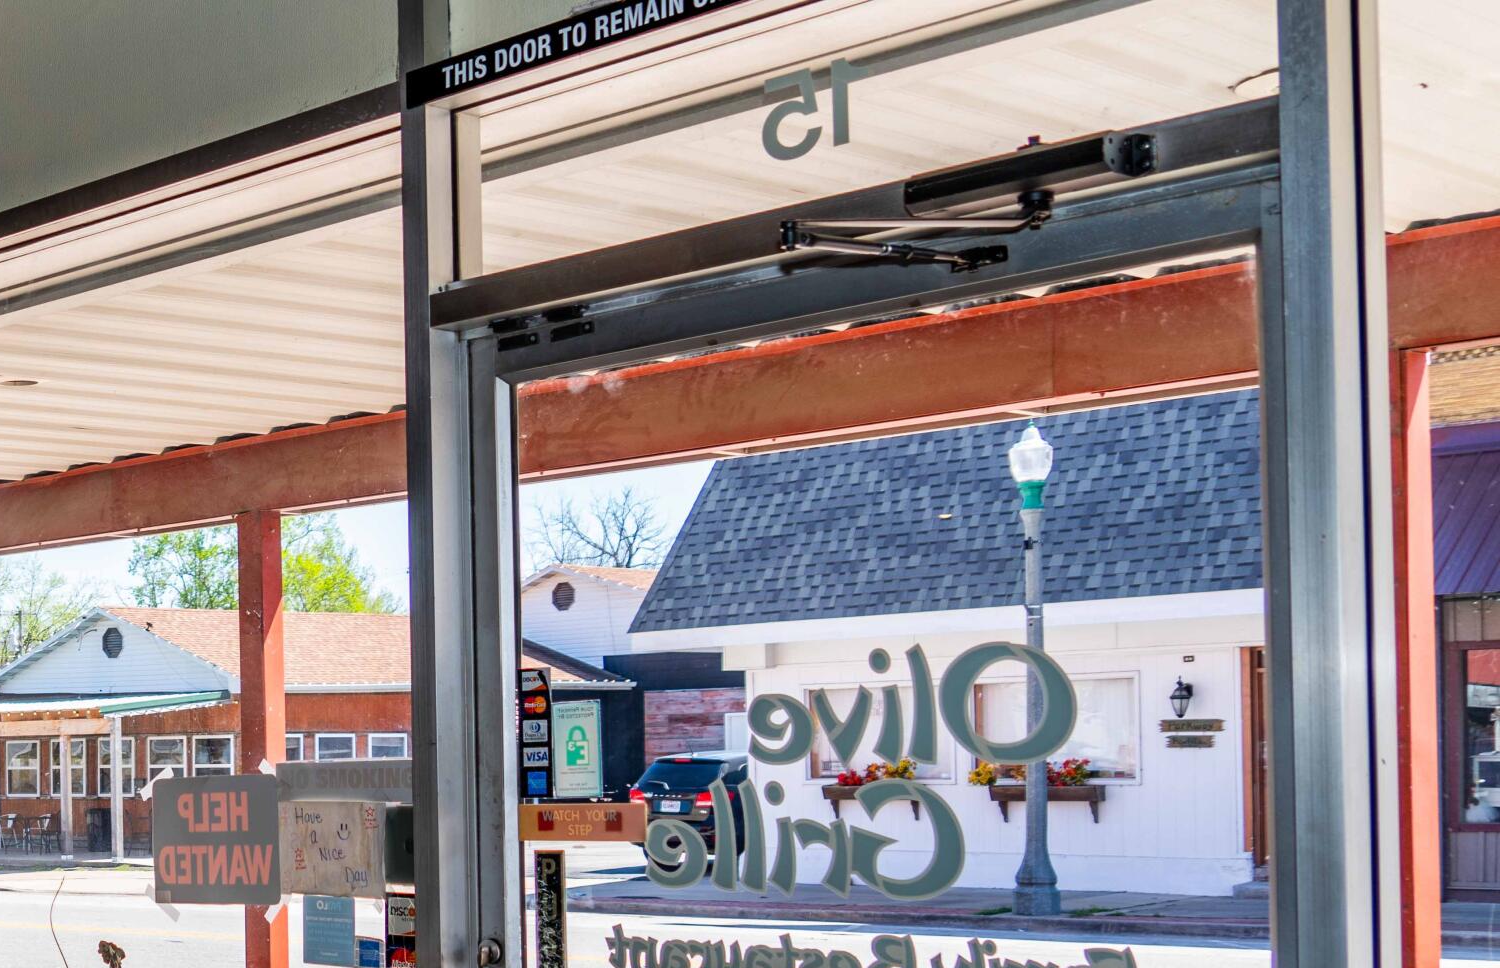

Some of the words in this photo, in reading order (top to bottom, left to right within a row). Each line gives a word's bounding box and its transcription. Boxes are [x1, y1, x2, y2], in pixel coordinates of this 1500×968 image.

[442, 55, 488, 88] THIS
[494, 33, 552, 73] DOOR
[558, 22, 587, 50] TO
[594, 0, 684, 41] REMAIN
[526, 751, 549, 762] VISA
[315, 767, 413, 789] SMOKING
[294, 807, 323, 825] Have
[542, 809, 580, 822] WATCH
[585, 809, 618, 822] YOUR
[568, 824, 593, 836] STEP
[318, 847, 346, 861] Nice
[345, 866, 368, 888] Day
[390, 906, 416, 917] DISCO
